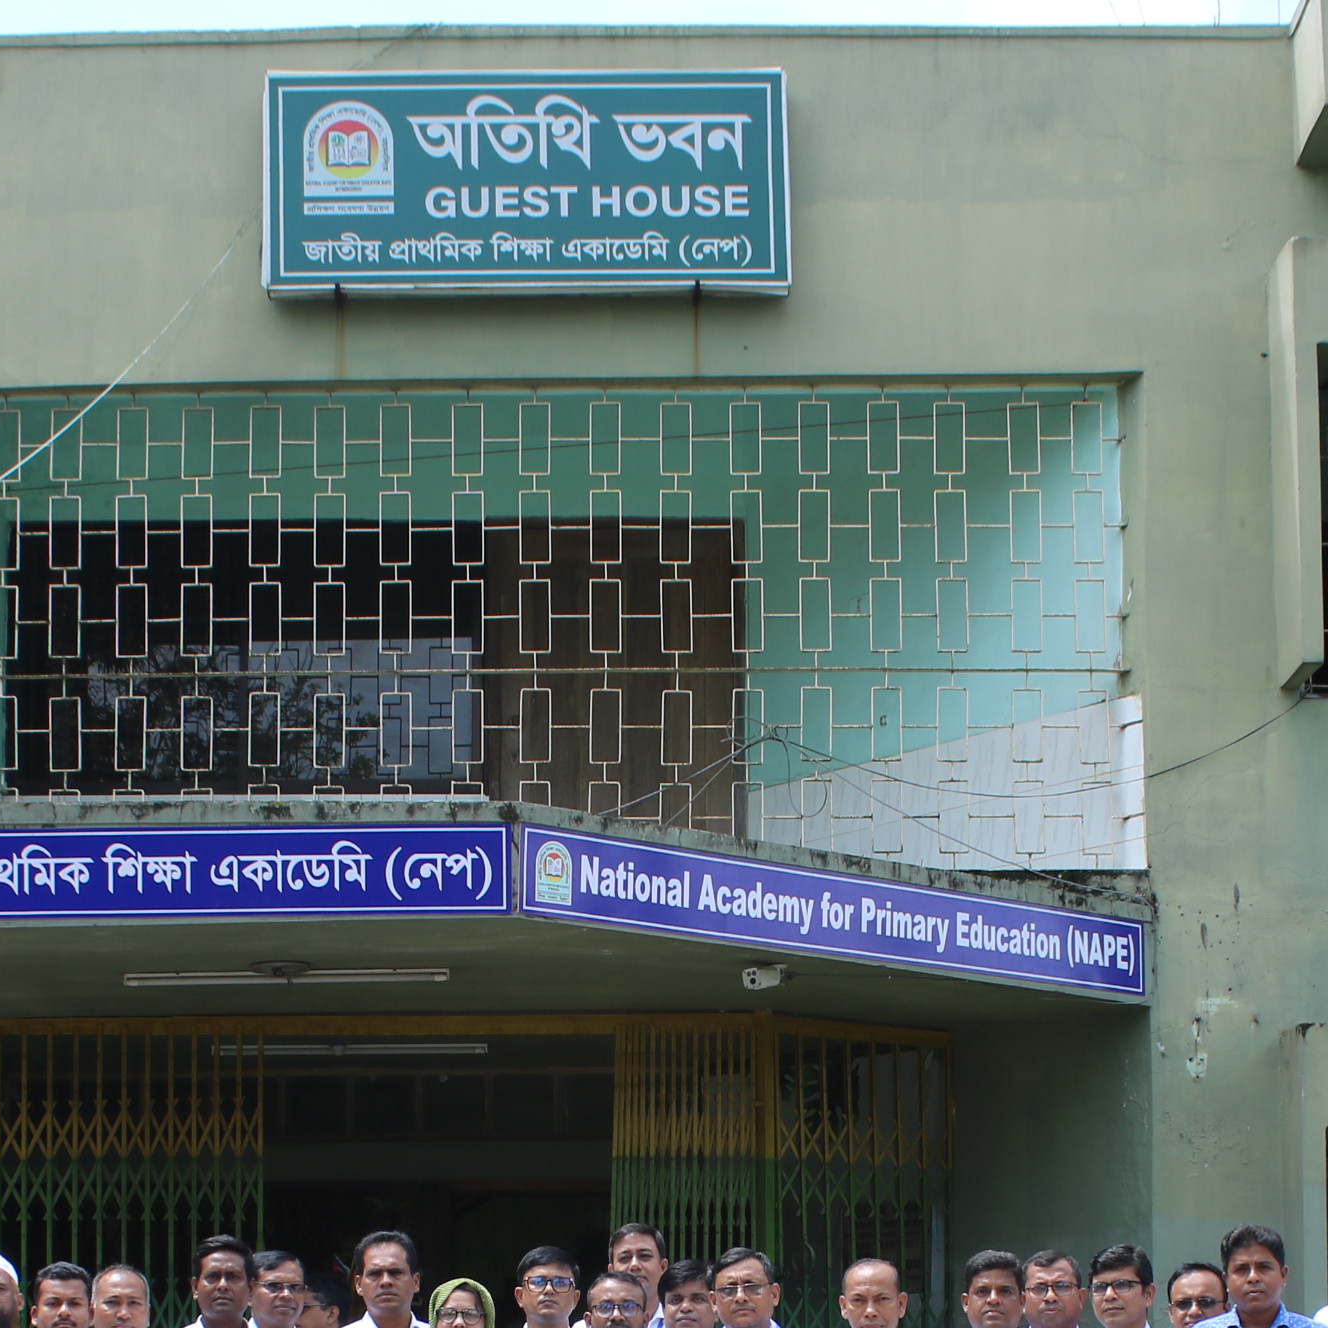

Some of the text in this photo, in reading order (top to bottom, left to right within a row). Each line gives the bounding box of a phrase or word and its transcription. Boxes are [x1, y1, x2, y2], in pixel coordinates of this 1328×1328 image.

[406, 94, 600, 171] অতিথি
[612, 114, 752, 172] ভবন
[425, 184, 750, 219] GUEST HOUSE
[302, 231, 753, 267] জাতীয় প্রাথমিক শিক্ষা একাডেমি (নেপ)
[101, 842, 198, 895] শিক্ষা
[210, 840, 373, 893] একাডেমি
[385, 846, 493, 901] (নেপ)
[579, 854, 690, 909] National
[697, 873, 814, 935] Academy
[820, 891, 855, 931] for
[861, 897, 950, 953] Primary
[956, 911, 1061, 960] Education
[1067, 924, 1135, 976] (NAPE)
